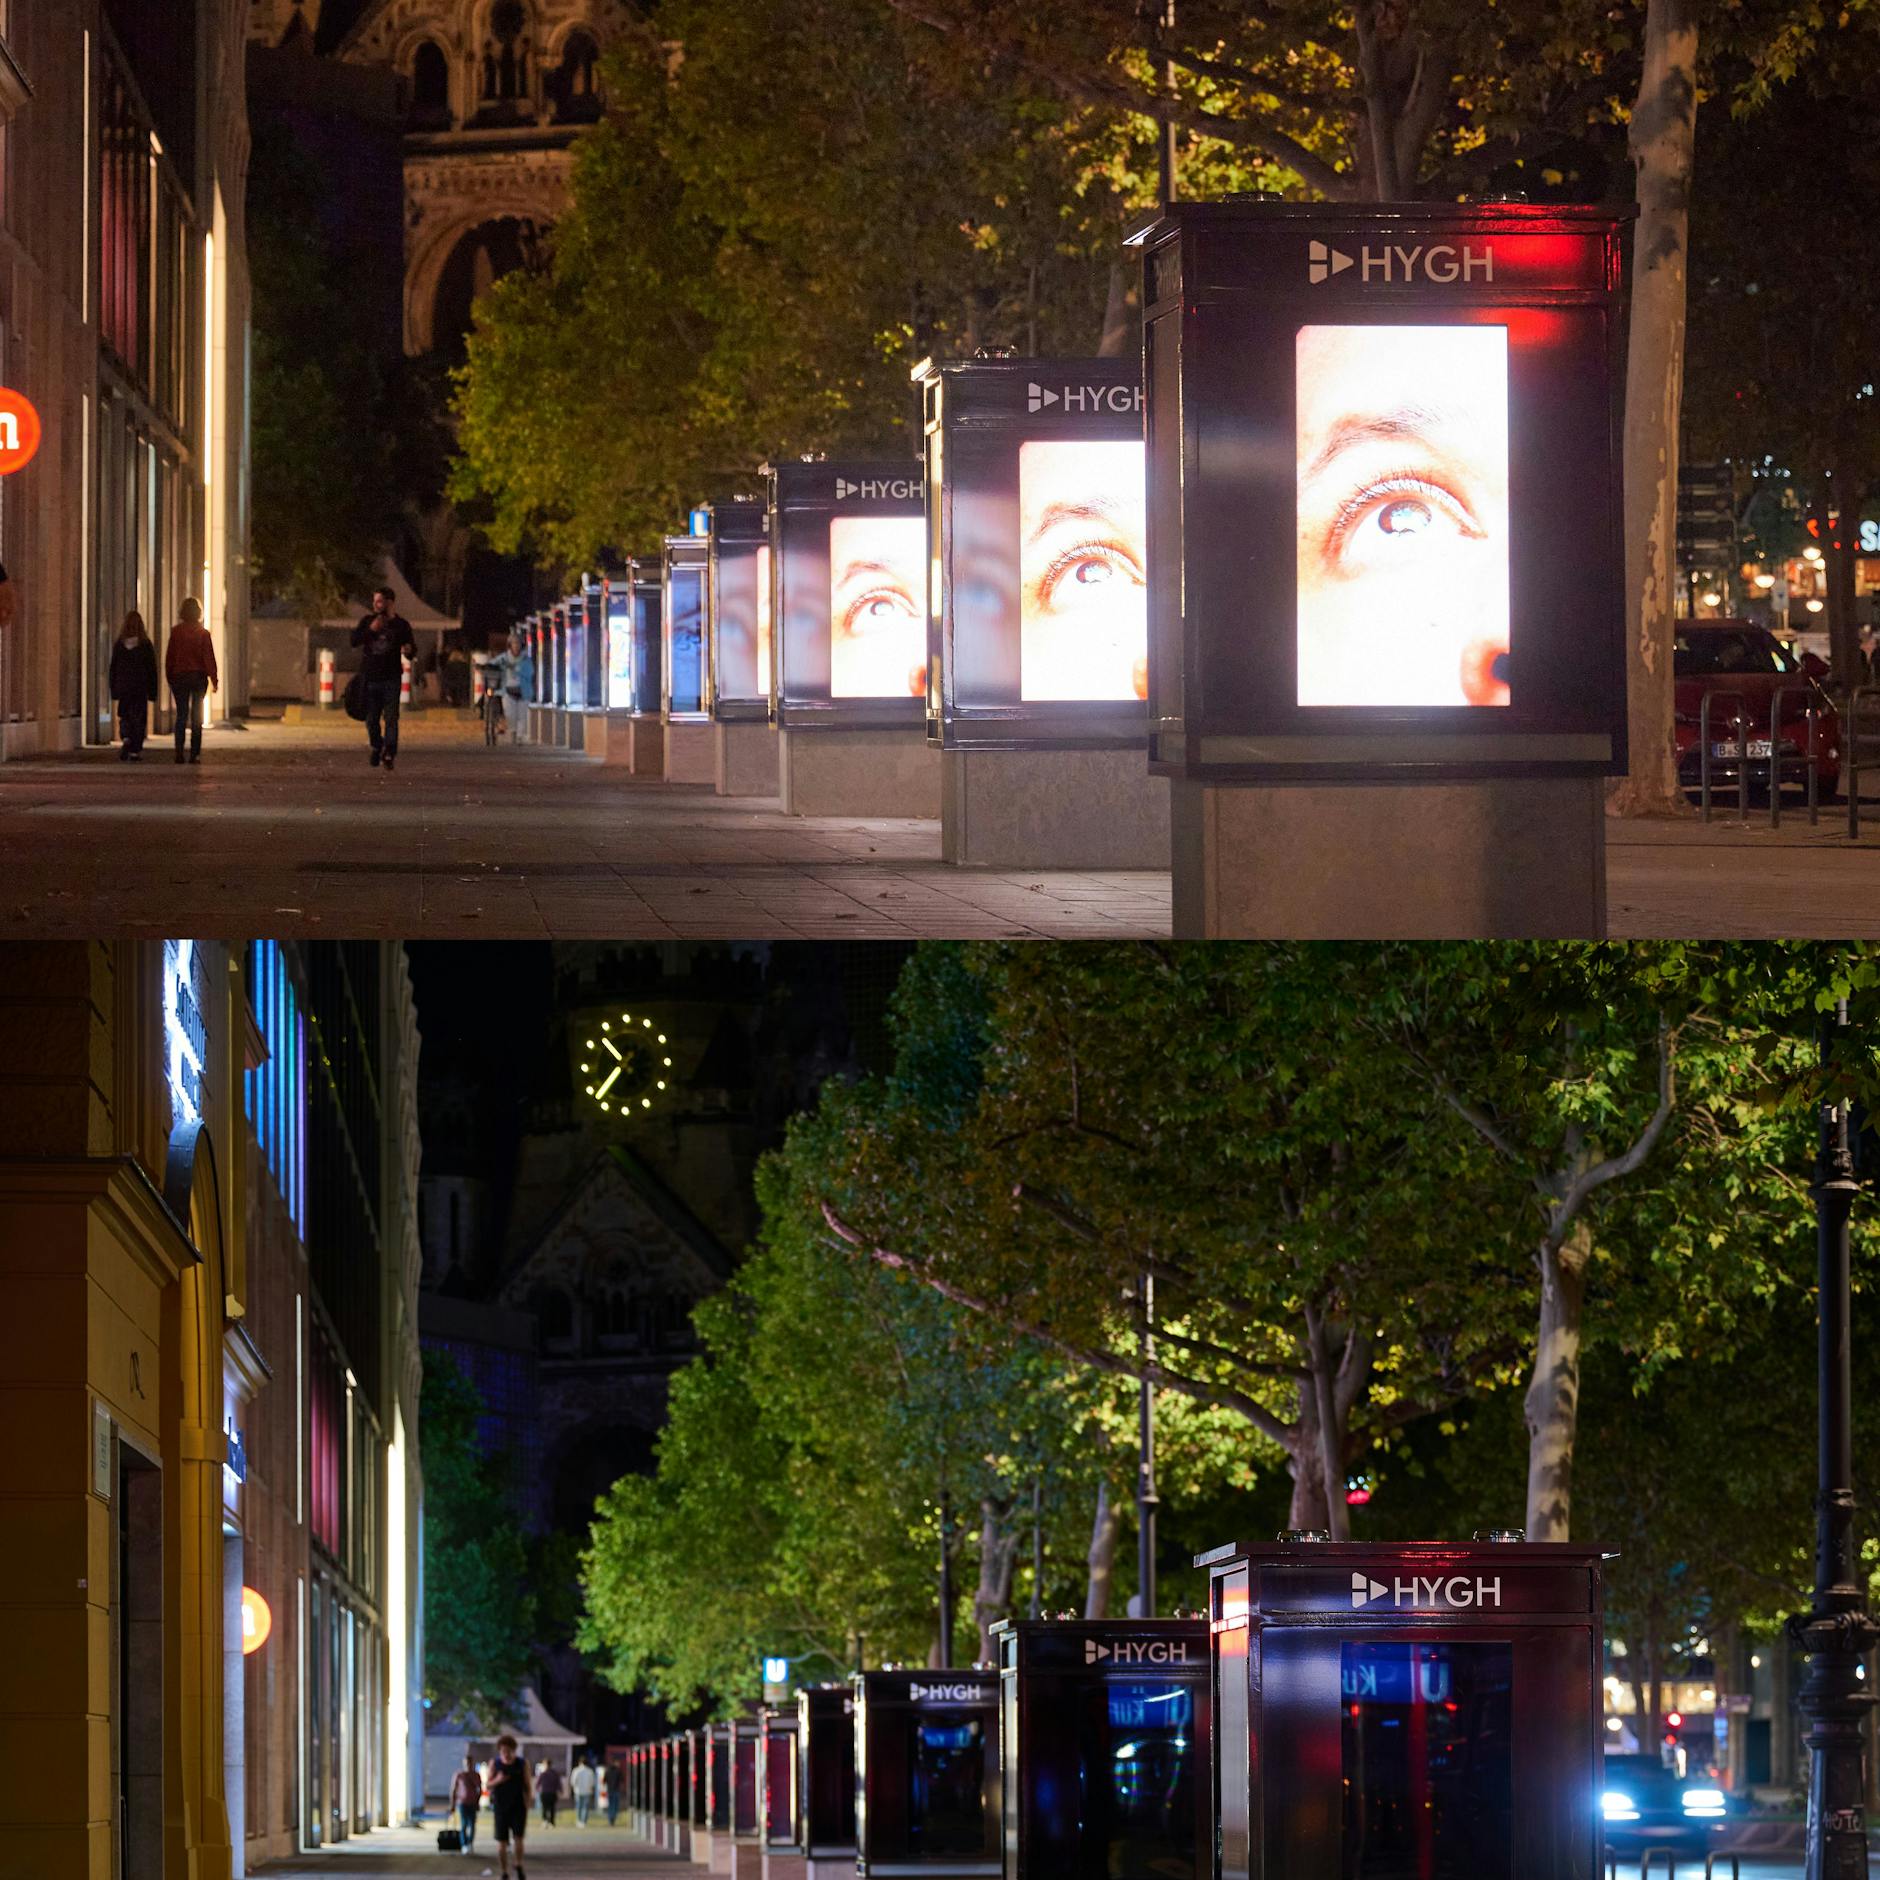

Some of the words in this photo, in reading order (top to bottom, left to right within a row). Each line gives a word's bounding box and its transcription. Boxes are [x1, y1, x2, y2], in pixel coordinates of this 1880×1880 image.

[1361, 244, 1494, 284] HYGH
[861, 480, 924, 499] HYGH
[1860, 520, 1880, 552] S
[1394, 1575, 1502, 1608] HYGH
[1113, 1641, 1187, 1664] HYGH
[766, 1659, 786, 1682] U
[928, 1683, 981, 1700] HYGH
